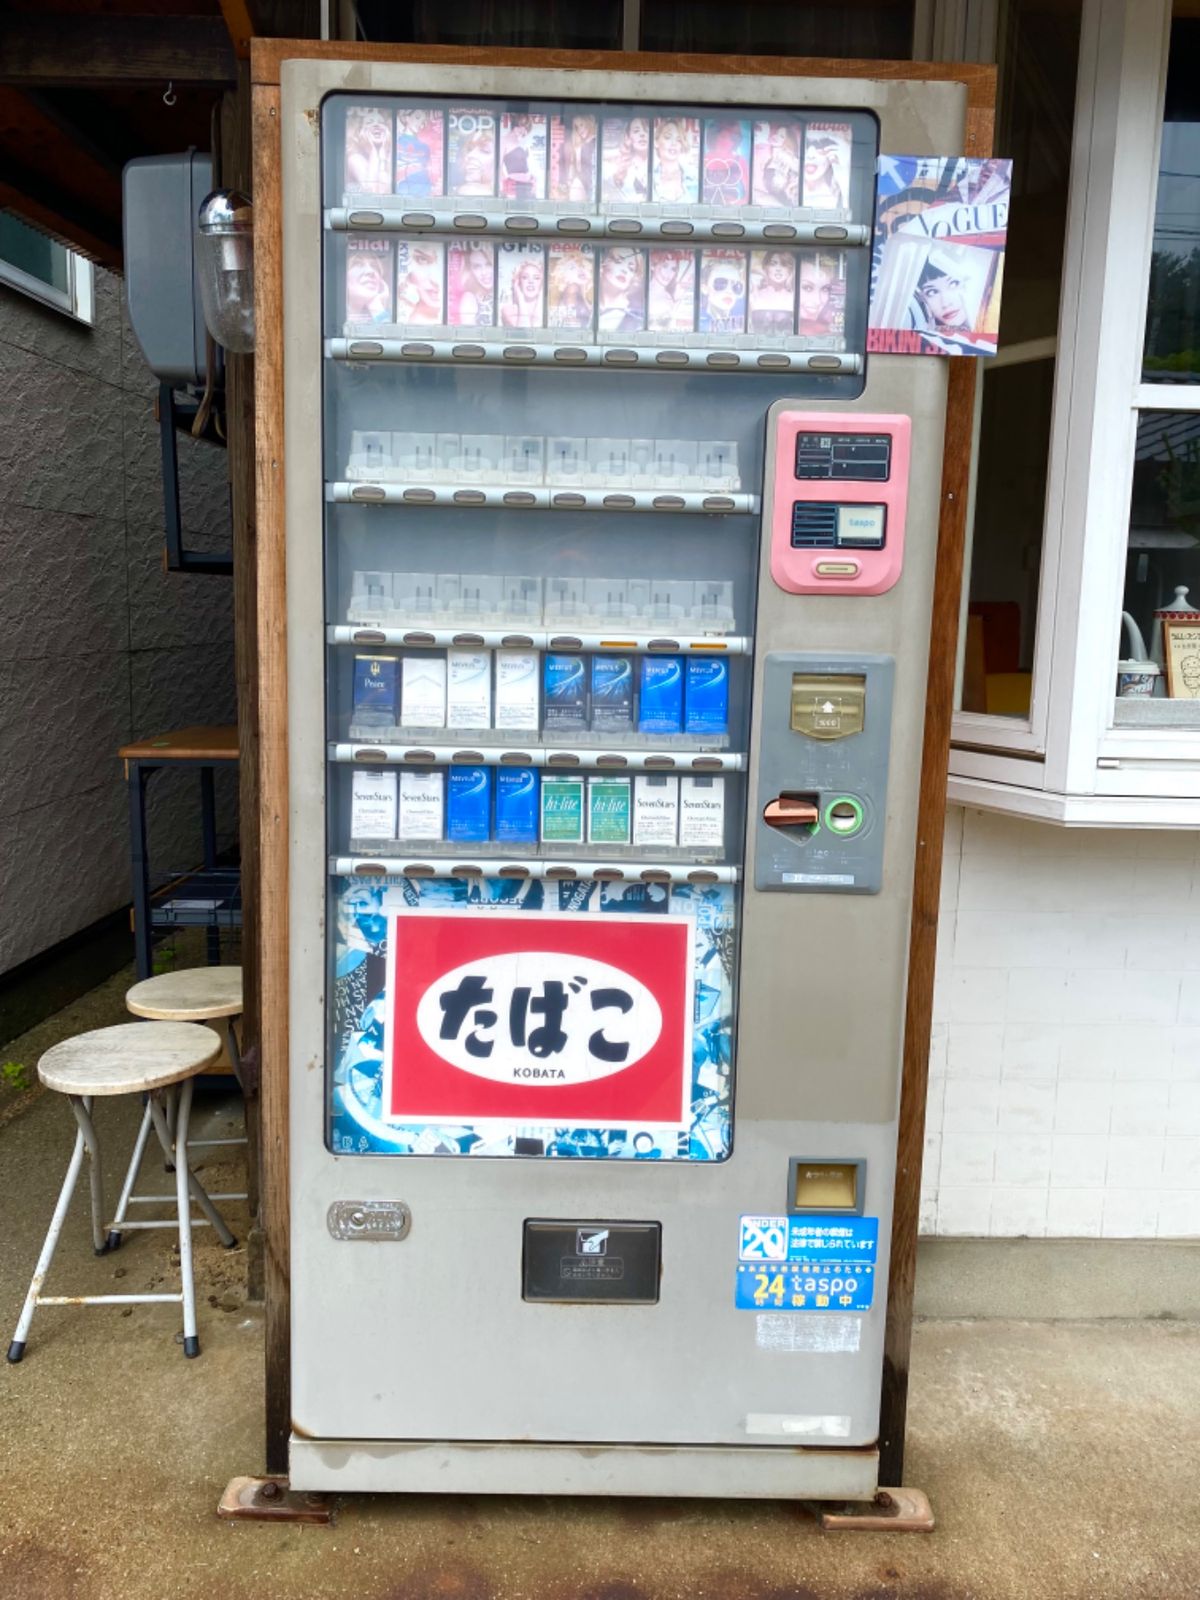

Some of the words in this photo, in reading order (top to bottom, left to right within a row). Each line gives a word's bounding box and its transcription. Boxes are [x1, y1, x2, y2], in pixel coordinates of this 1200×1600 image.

[439, 975, 634, 1063] たばこ
[513, 1068, 565, 1079] KOBATA
[753, 1273, 786, 1299] 24
[791, 1274, 858, 1297] taspo
